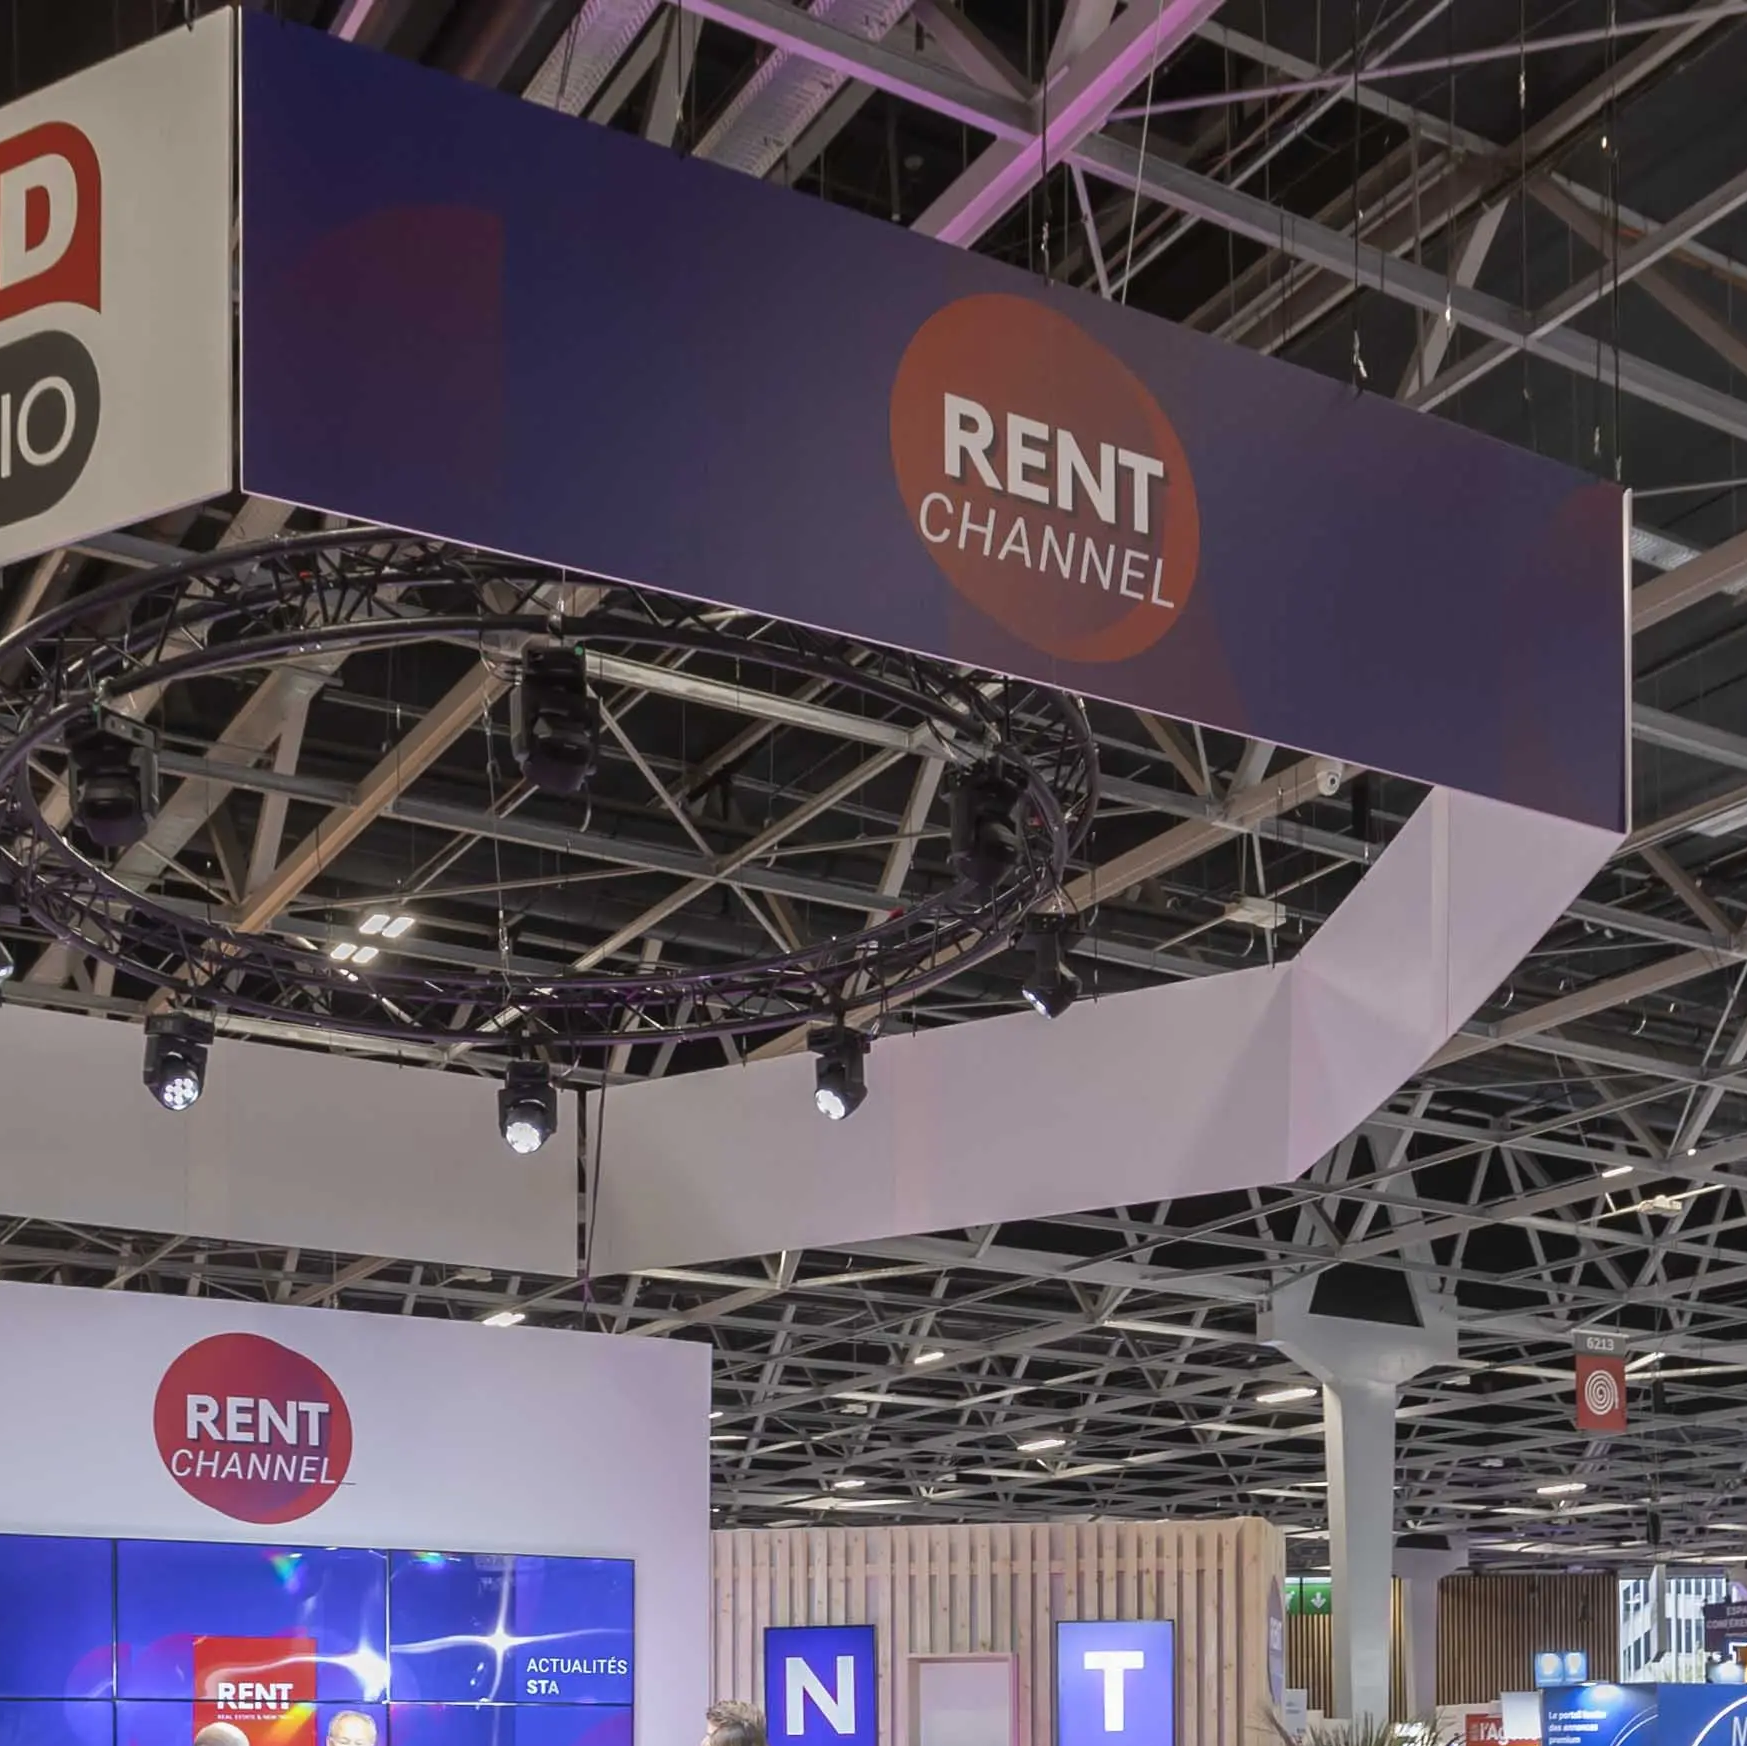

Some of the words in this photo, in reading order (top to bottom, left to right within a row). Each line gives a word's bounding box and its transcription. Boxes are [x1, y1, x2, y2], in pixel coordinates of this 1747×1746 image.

[944, 391, 1164, 534] RENT
[919, 491, 1175, 609] CHANNEL
[1587, 1337, 1614, 1351] 6213
[186, 1393, 330, 1446] RENT
[171, 1449, 337, 1484] CHANNEL
[526, 1656, 628, 1675] ACTUALITÉS
[526, 1680, 560, 1695] STA
[217, 1682, 294, 1710] RENT
[785, 1654, 856, 1736] N
[1083, 1650, 1145, 1733] T
